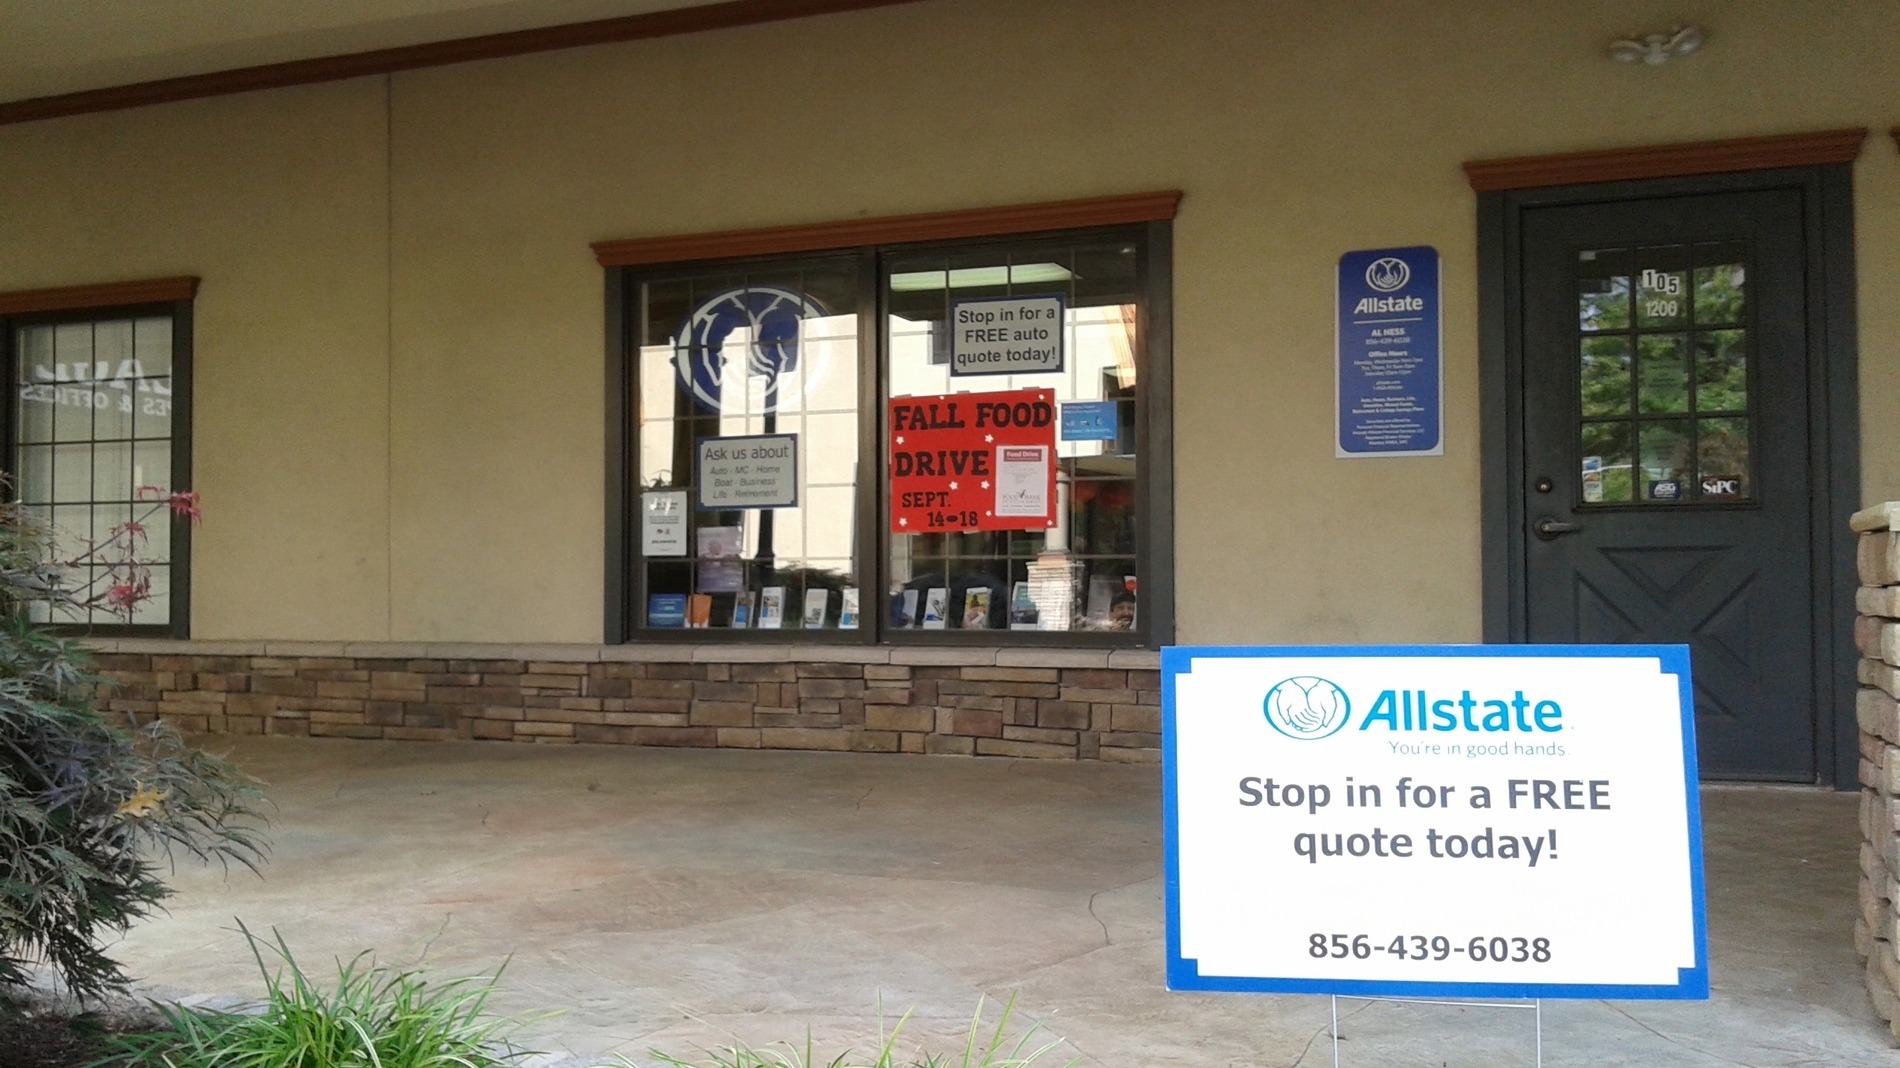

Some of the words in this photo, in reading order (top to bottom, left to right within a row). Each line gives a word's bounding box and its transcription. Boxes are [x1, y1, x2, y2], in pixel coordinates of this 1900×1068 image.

[1645, 271, 1679, 293] 105
[1354, 295, 1423, 314] Allstate
[1646, 301, 1678, 316] 1200
[958, 310, 995, 325] Stop
[999, 308, 1014, 321] in
[1019, 307, 1041, 320] for
[1046, 308, 1055, 319] a
[965, 328, 1008, 343] FREE
[1013, 327, 1048, 341] auto
[957, 348, 1001, 366] quote
[1006, 346, 1056, 363] today!
[893, 403, 965, 431] FALL
[975, 402, 1051, 428] FOOD
[704, 447, 727, 461] Ask
[732, 449, 747, 460] us
[751, 445, 789, 459] about
[894, 450, 989, 477] DRIVE
[902, 492, 951, 508] SEPT.
[1359, 690, 1563, 732] Allstate
[1389, 740, 1441, 756] You're
[1446, 741, 1462, 756] in
[1466, 741, 1509, 758] good
[1238, 776, 1331, 815] Stop
[1347, 776, 1382, 808] in
[1396, 777, 1456, 809] for
[1470, 783, 1492, 809] a
[1508, 778, 1611, 810] FREE
[1293, 826, 1414, 864] quote
[1427, 827, 1559, 868] today!
[1308, 933, 1552, 964] 856-439-6038
